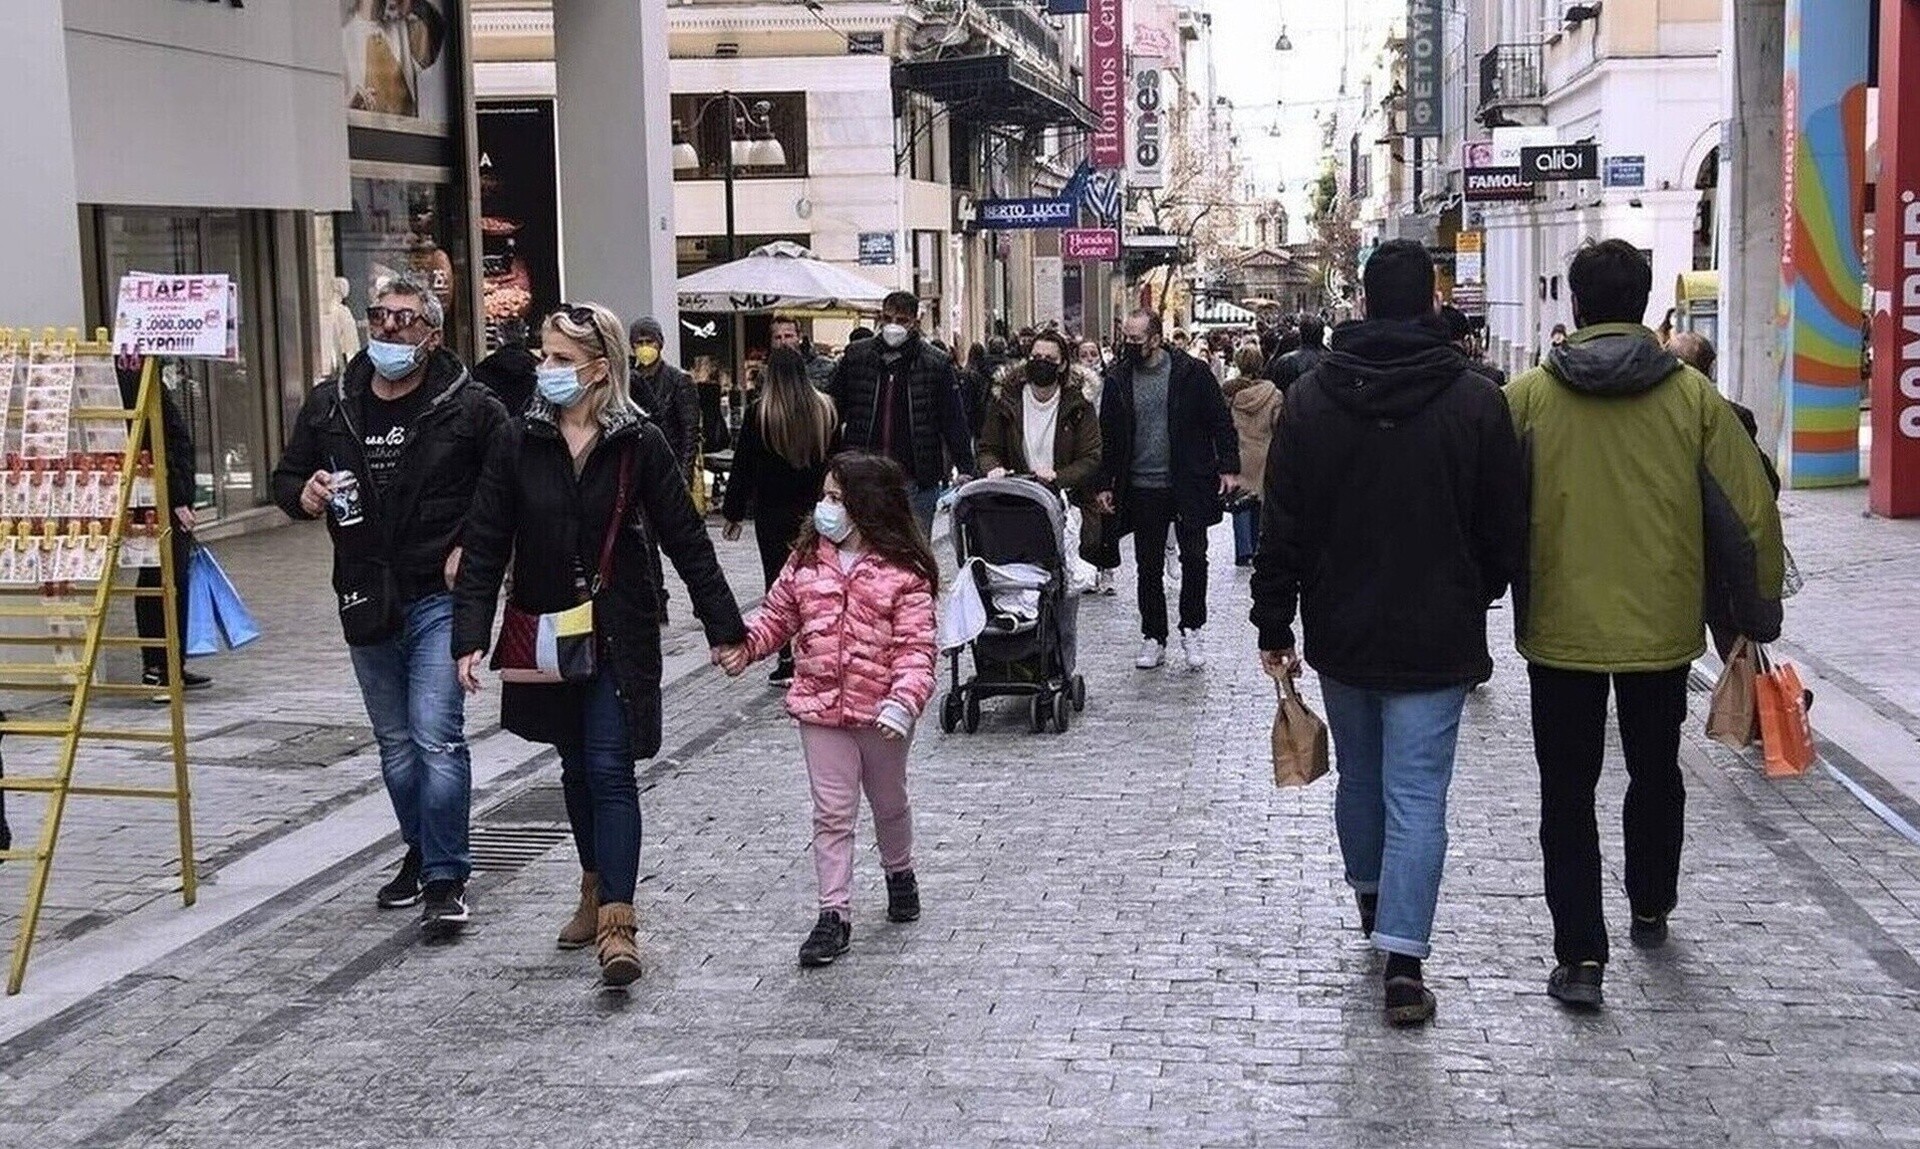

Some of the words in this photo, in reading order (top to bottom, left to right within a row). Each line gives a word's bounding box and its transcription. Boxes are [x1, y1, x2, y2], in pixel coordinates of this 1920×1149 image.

[1094, 57, 1118, 153] Hondos
[1536, 149, 1583, 171] alibi
[1468, 174, 1533, 189] FAMOU
[1070, 234, 1113, 245] Hondos
[1070, 245, 1109, 256] Center
[138, 279, 203, 298] ΠΑΡΕ
